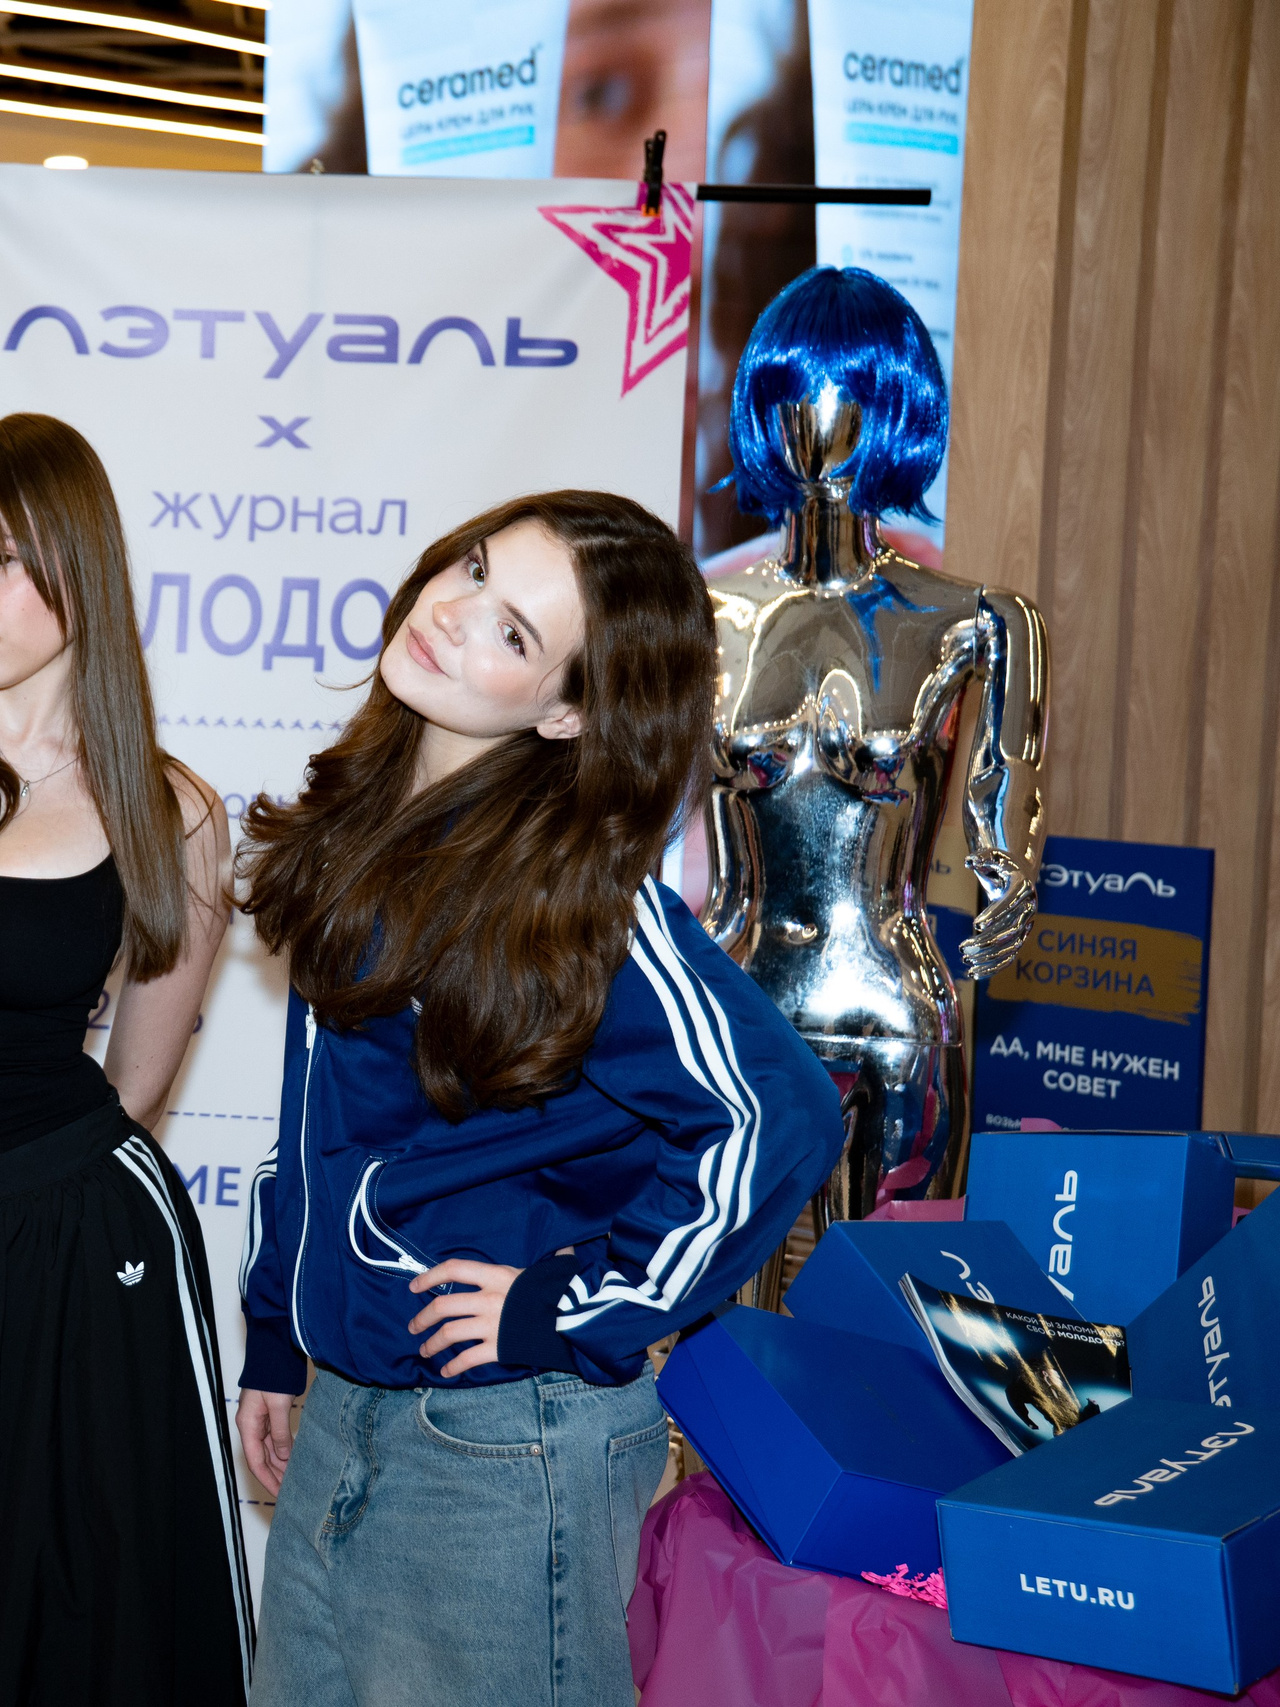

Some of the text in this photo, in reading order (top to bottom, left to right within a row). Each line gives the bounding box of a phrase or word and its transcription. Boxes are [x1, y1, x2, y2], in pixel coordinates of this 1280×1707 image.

[398, 49, 536, 109] ceramed
[843, 52, 962, 95] ceramed
[149, 490, 407, 542] журнал
[1037, 929, 1138, 962] СИНЯЯ
[1016, 960, 1155, 998] КОРЗИНА
[990, 1034, 1180, 1081] ДА, МНЕ НУЖЕН
[1043, 1069, 1121, 1099] СОВЕТ
[1005, 1311, 1039, 1326] КАКОЙ
[1057, 1330, 1125, 1347] МОЛОДОСТЬ?
[1020, 1573, 1135, 1610] LETU.RU
